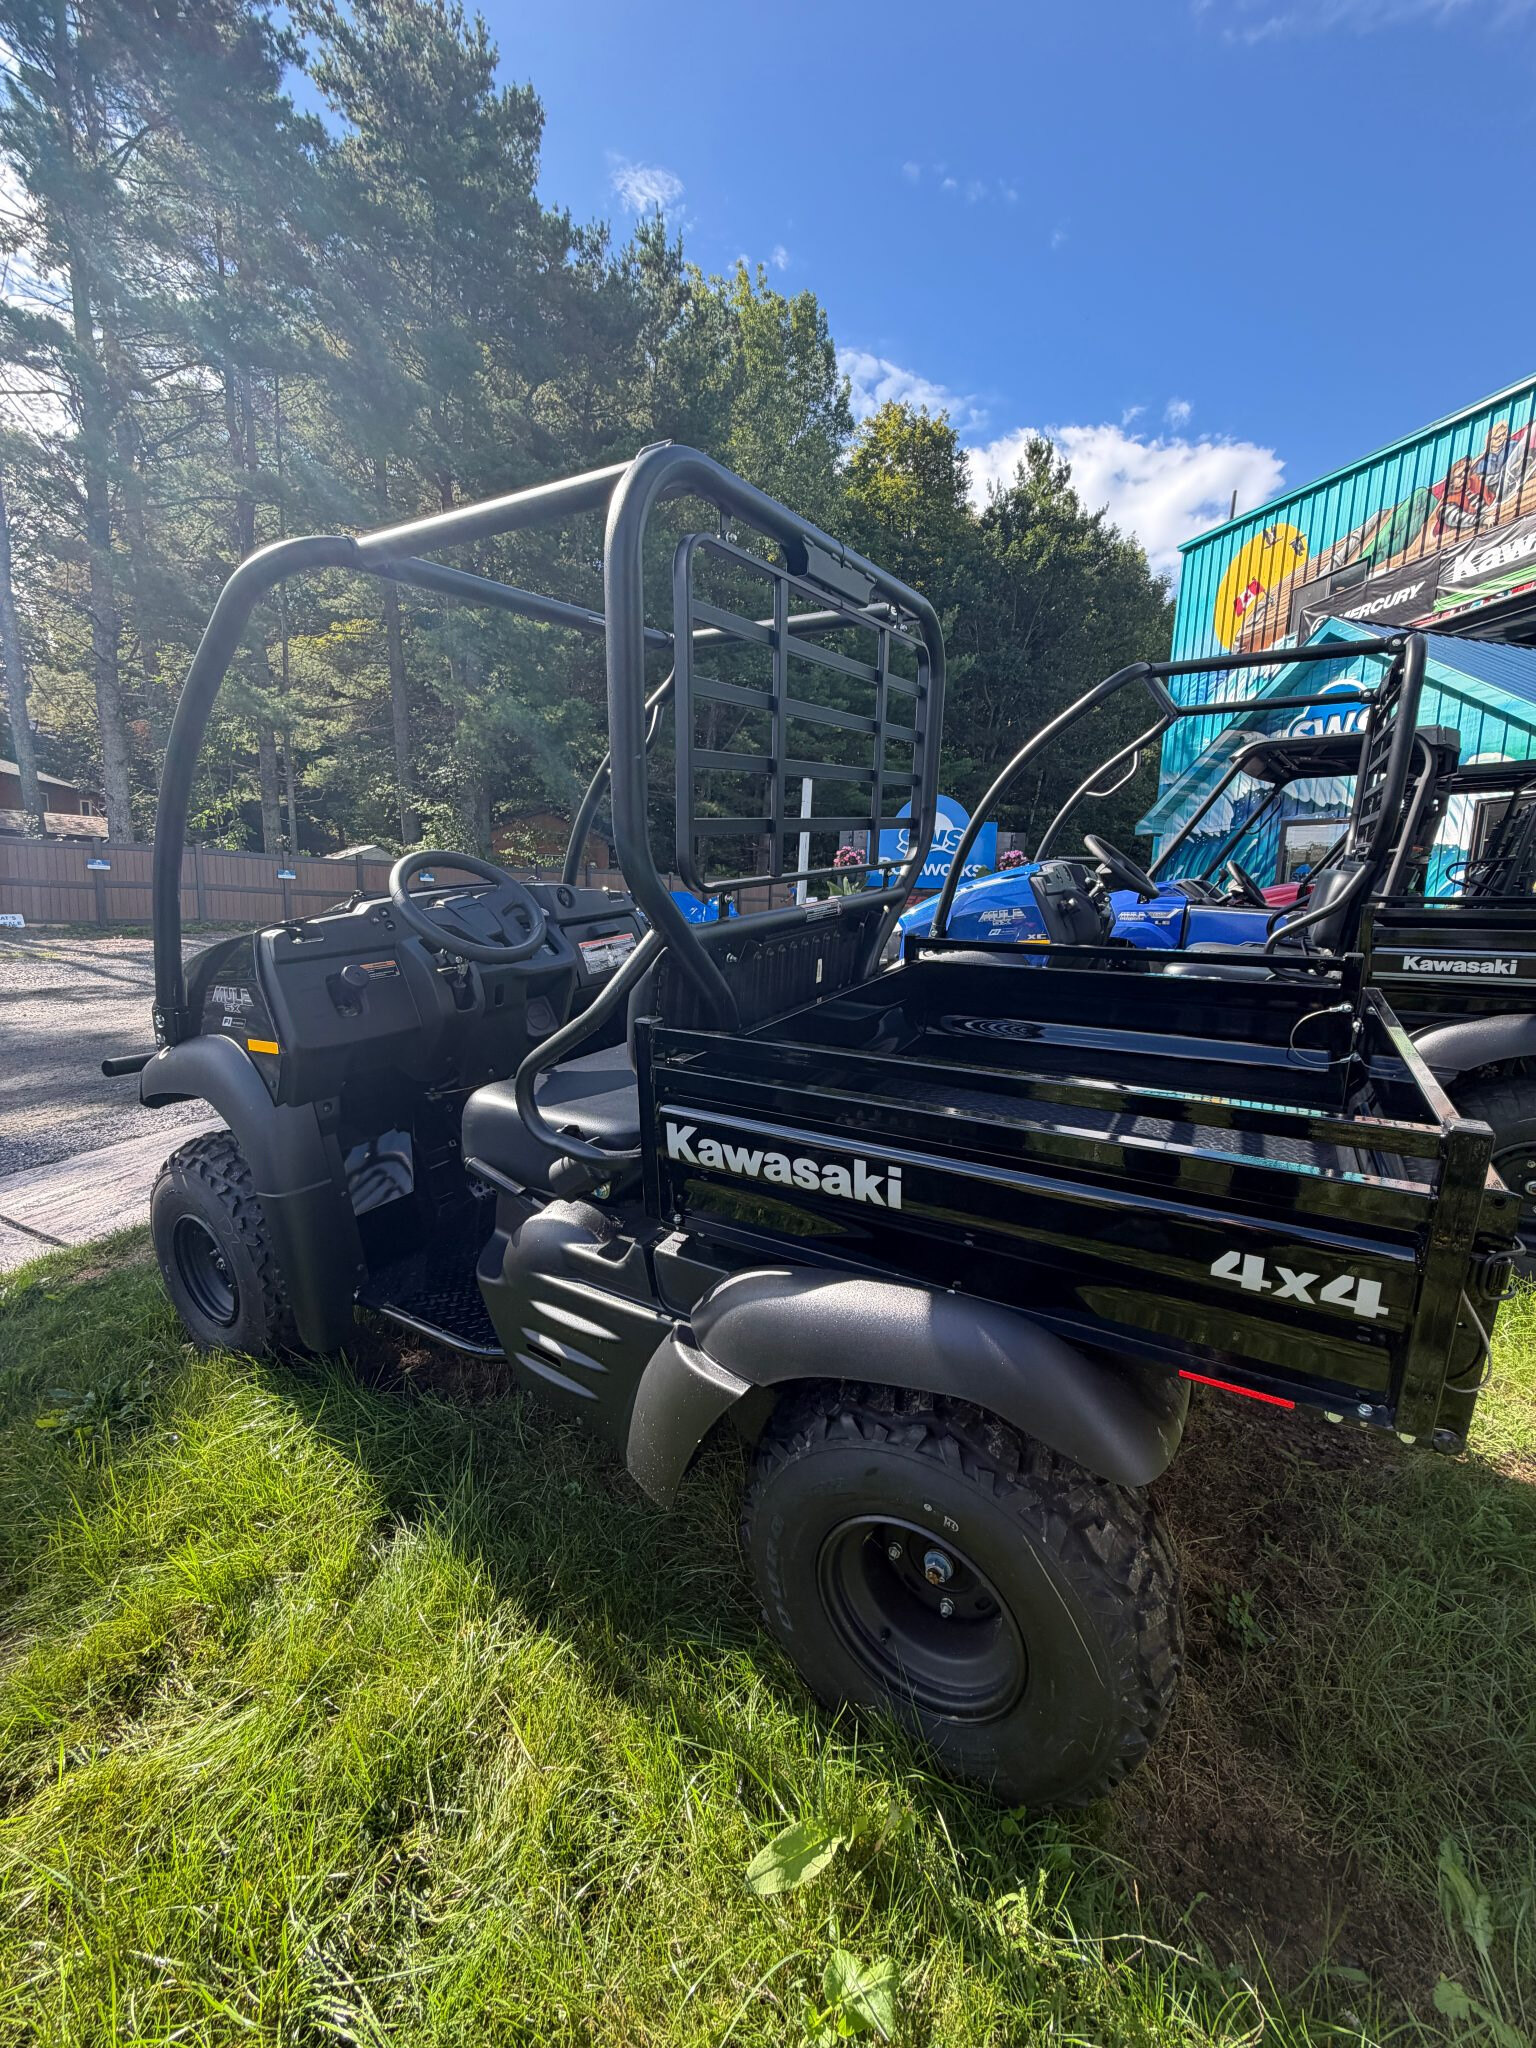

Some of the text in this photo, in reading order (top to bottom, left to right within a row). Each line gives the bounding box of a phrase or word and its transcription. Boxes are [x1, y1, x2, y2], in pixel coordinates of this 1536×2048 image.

[1402, 956, 1518, 975] Kawasaki
[211, 985, 255, 1007] MULE
[665, 1122, 902, 1210] Kawasaki
[1210, 1250, 1389, 1319] 4x4
